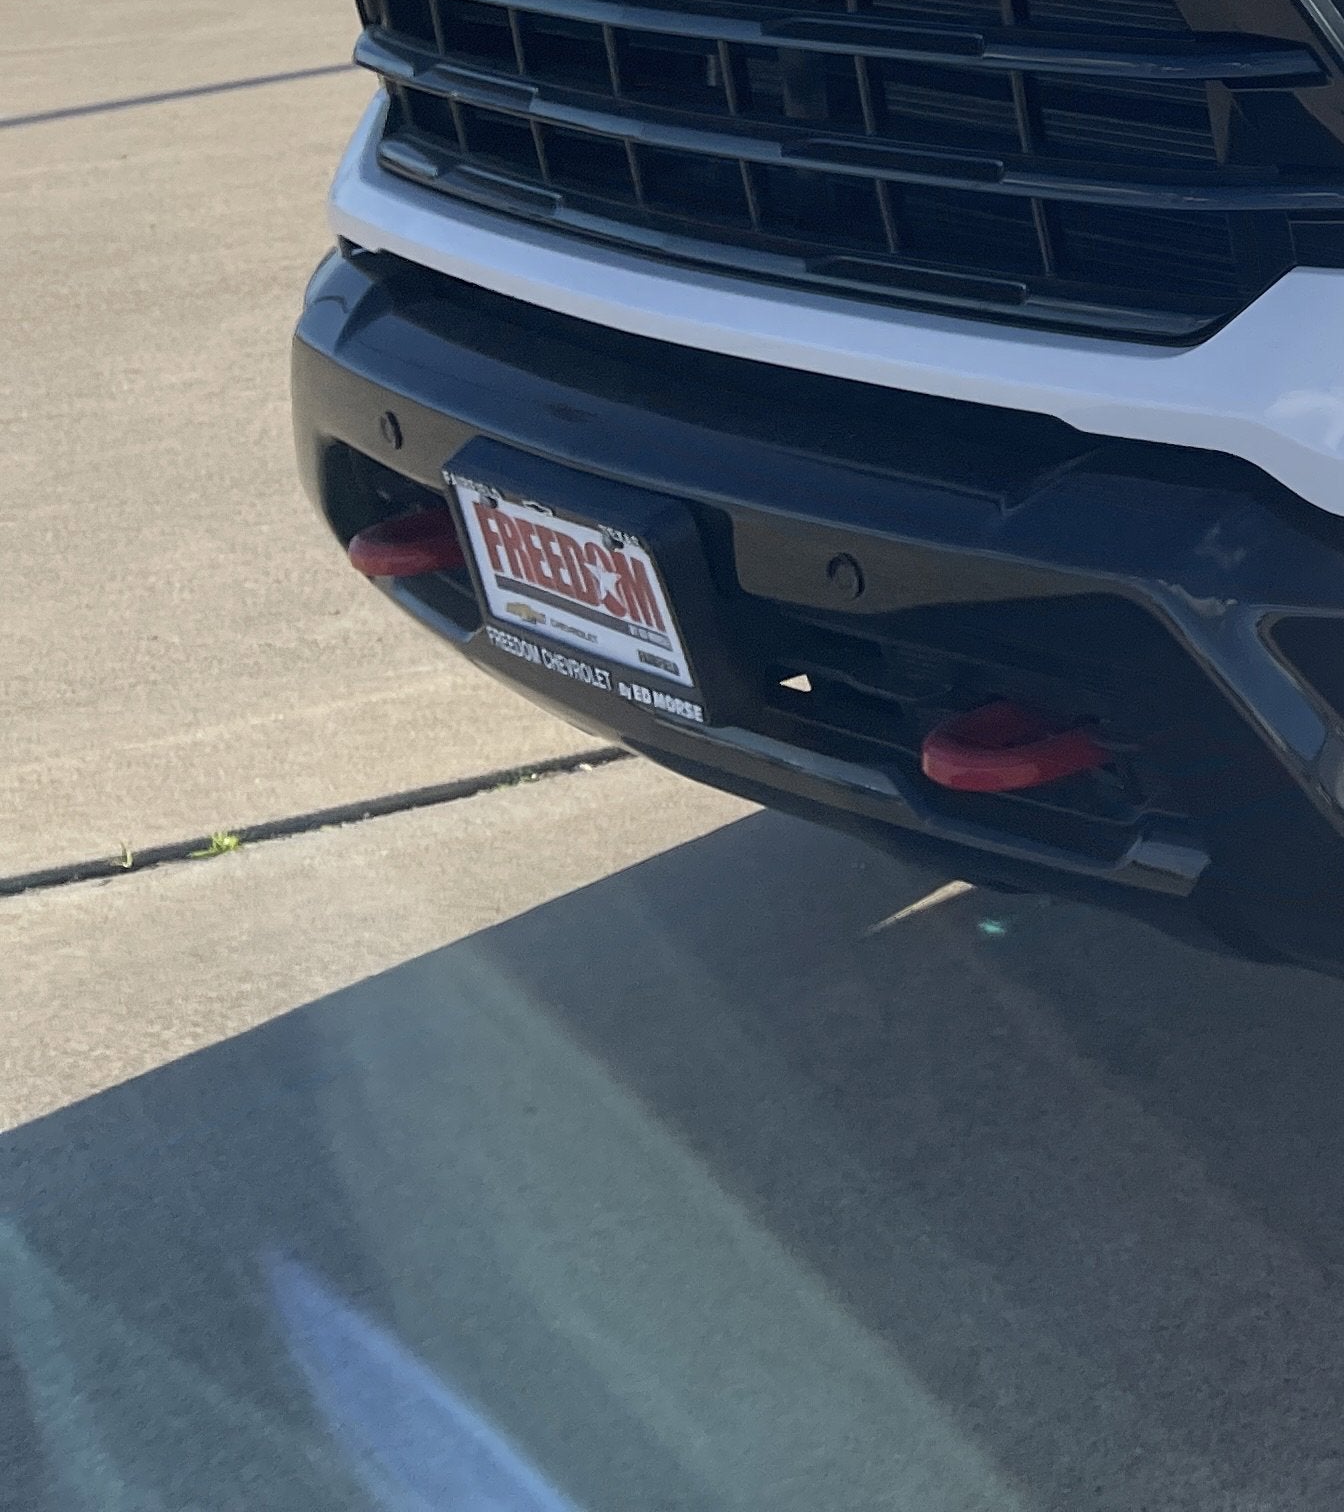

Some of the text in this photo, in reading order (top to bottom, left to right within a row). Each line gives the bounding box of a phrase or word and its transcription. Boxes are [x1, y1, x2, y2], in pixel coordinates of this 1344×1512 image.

[473, 501, 667, 634] FREEDOM
[485, 625, 541, 664] FREEDOM
[541, 648, 612, 691] CHEVROLET
[632, 683, 652, 705] ED
[652, 690, 704, 723] MORSE
